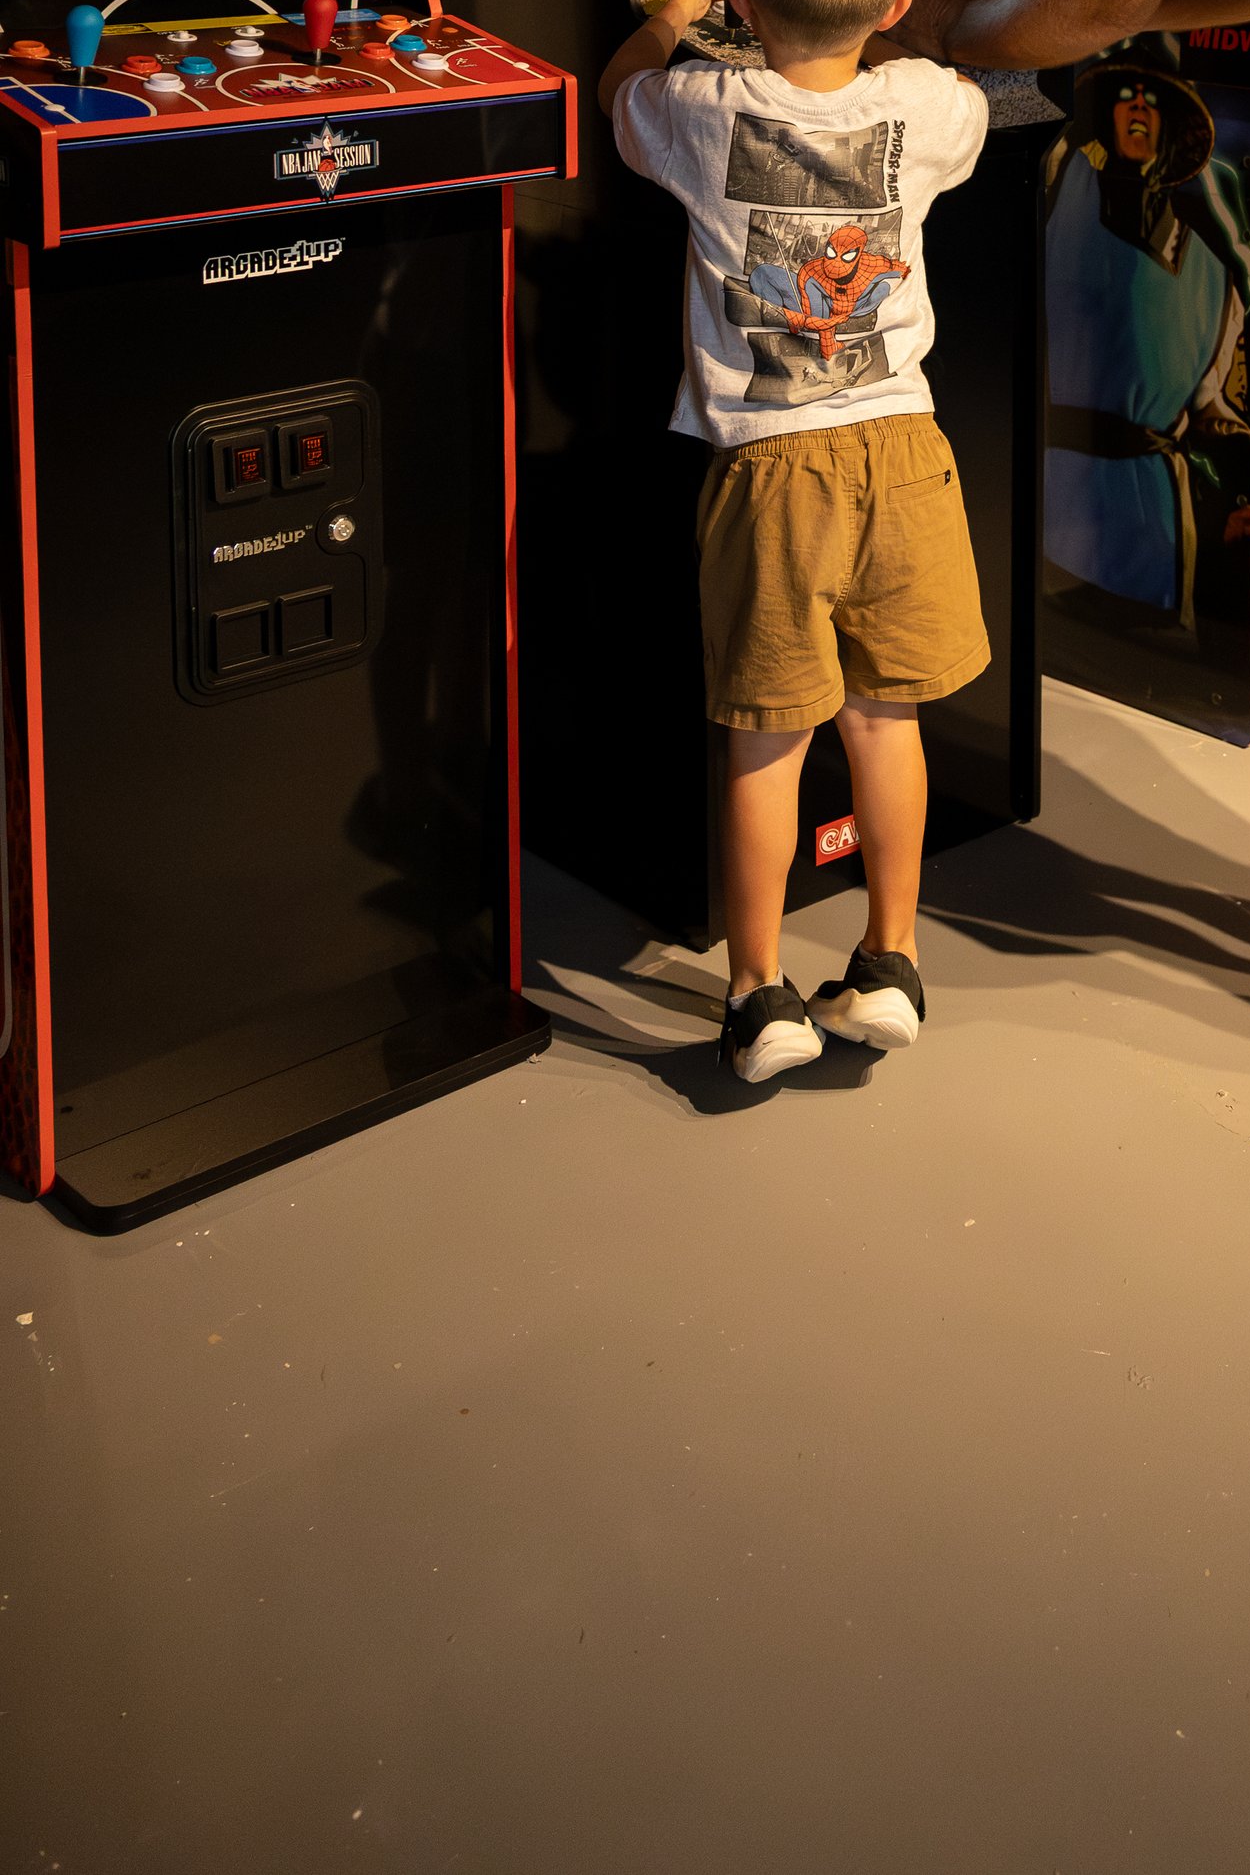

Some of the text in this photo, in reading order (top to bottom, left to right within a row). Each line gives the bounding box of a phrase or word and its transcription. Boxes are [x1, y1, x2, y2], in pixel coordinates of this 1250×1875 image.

[282, 153, 301, 175] NBA
[334, 144, 371, 169] SESSION
[887, 119, 906, 204] SPIDER-MAN
